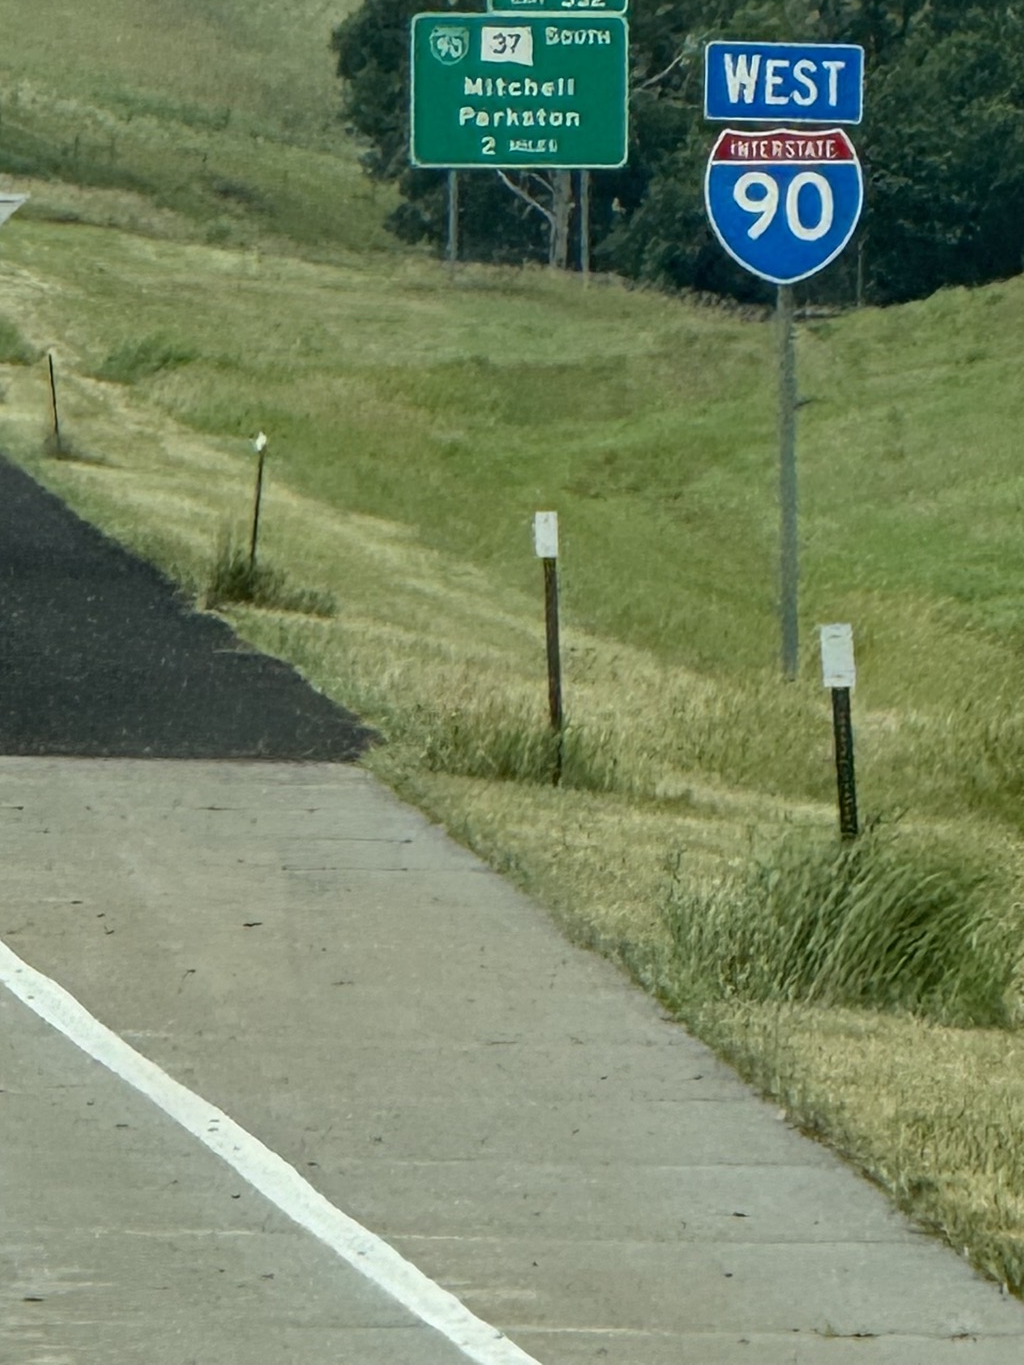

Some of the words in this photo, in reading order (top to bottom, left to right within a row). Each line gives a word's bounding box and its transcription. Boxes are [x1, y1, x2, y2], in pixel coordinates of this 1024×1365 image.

[492, 33, 521, 54] 37
[464, 76, 575, 97] Mitchell
[724, 53, 846, 107] WEST
[481, 136, 496, 155] 2
[730, 139, 837, 159] INTERSTATE
[733, 171, 834, 241] 90
